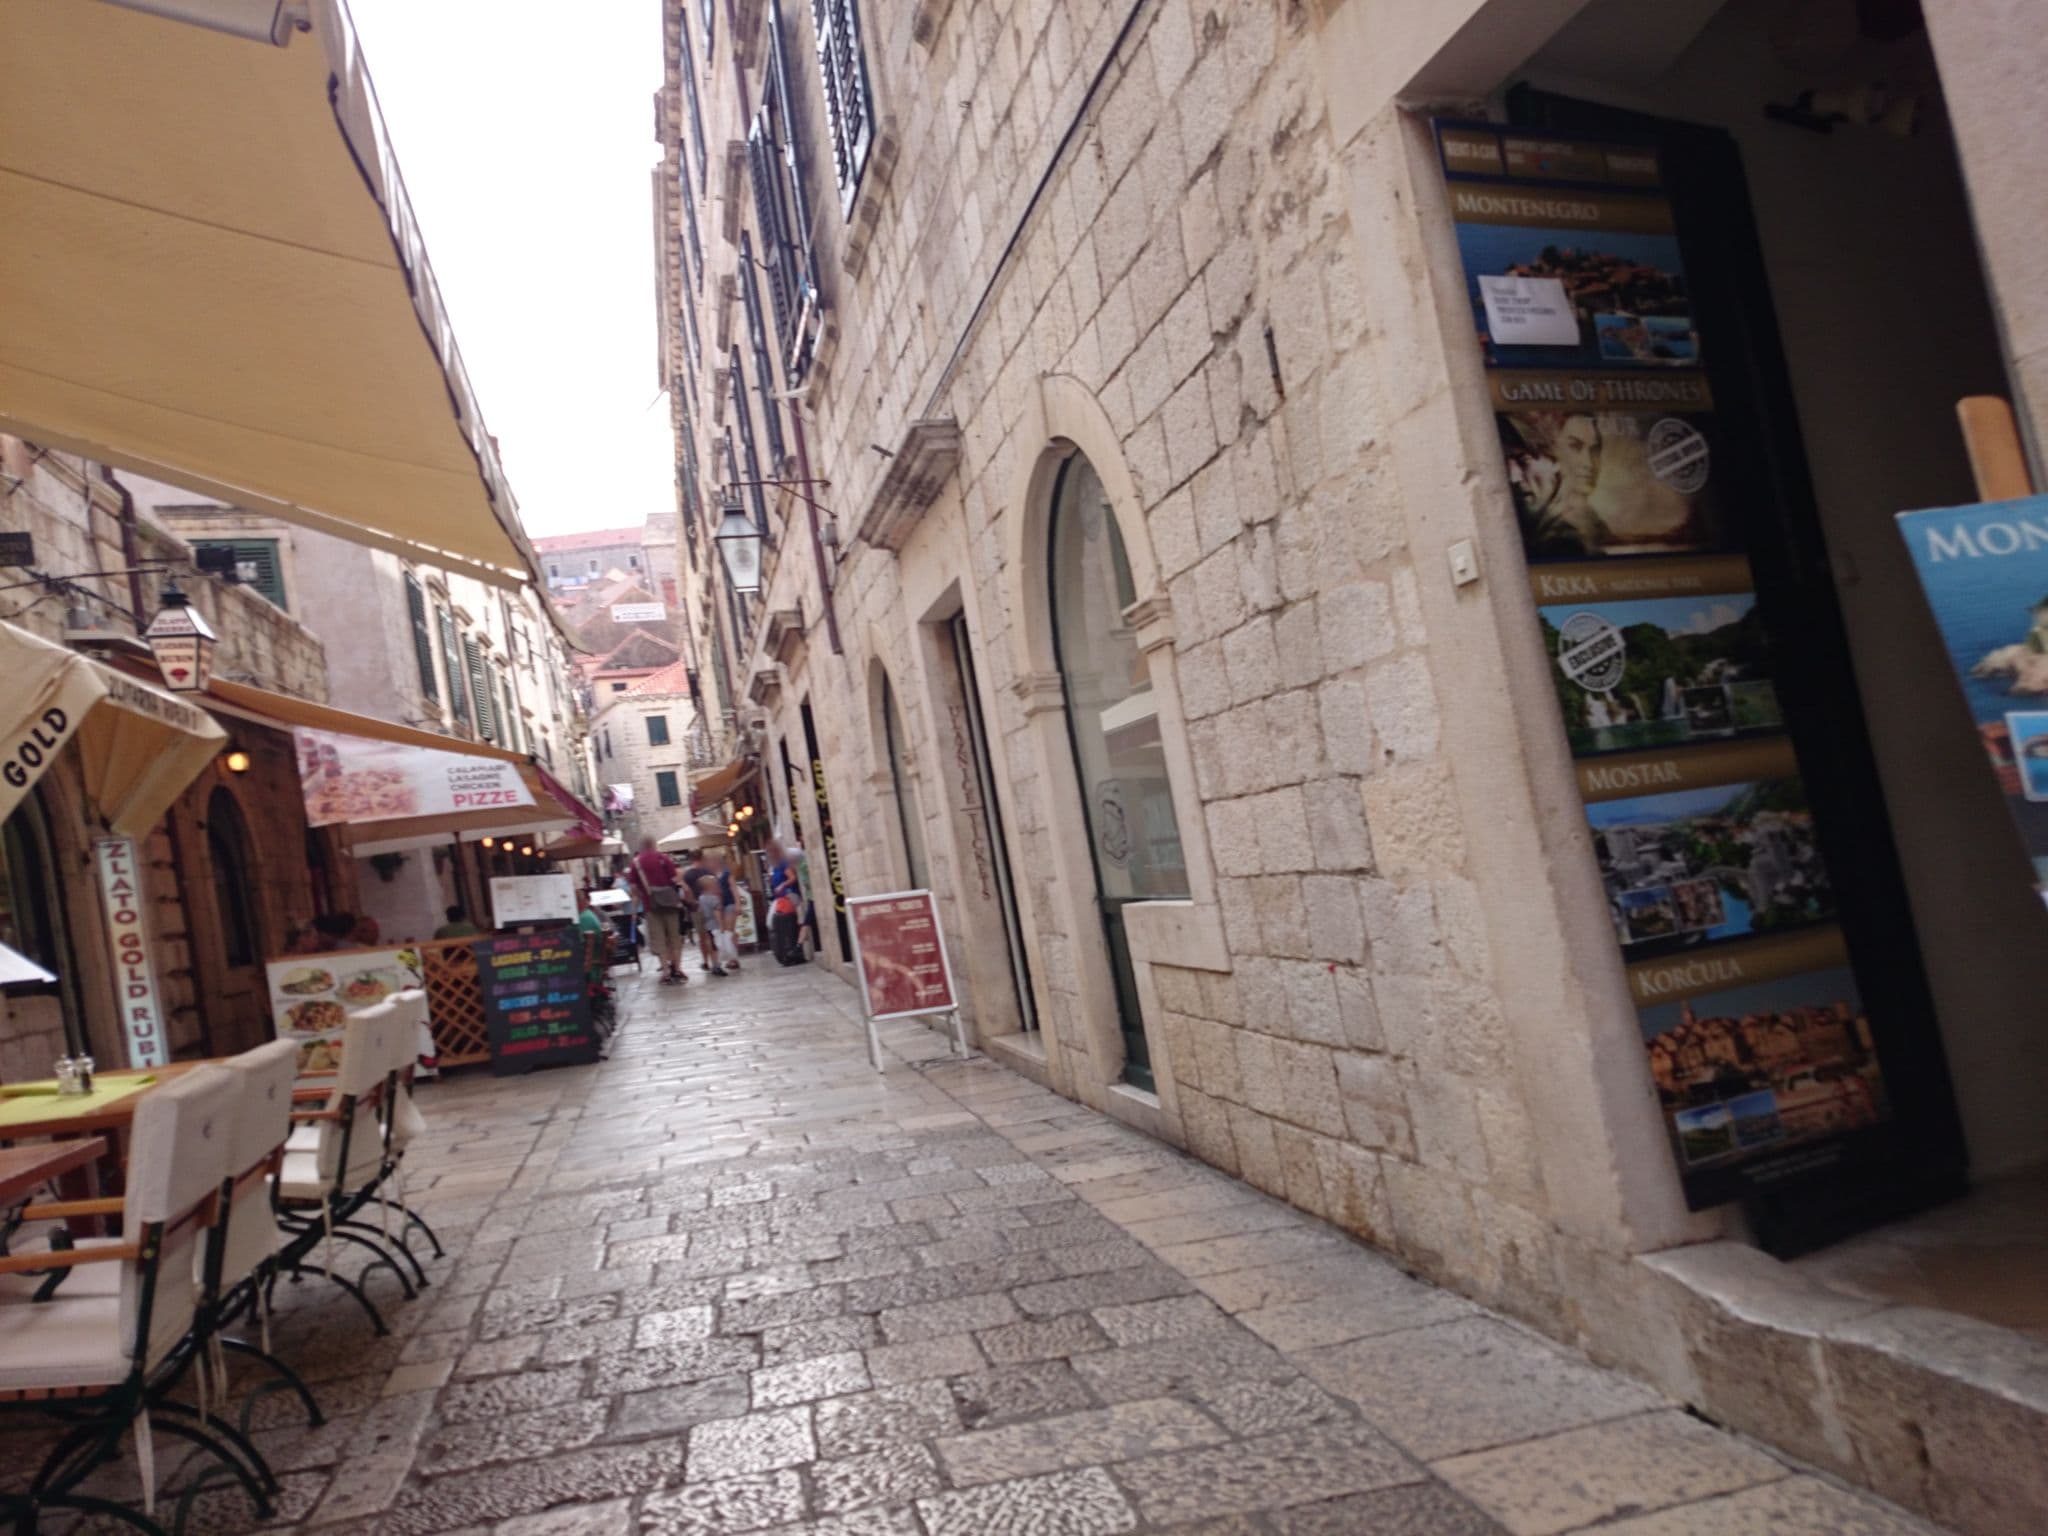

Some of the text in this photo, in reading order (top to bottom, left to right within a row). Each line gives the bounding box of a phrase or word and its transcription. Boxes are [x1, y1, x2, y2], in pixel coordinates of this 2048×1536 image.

[1457, 193, 1600, 221] MONTENEGRO
[1500, 379, 1700, 401] GAME OF THRONES
[1926, 516, 2048, 563] MON
[1539, 574, 1598, 597] KRKA
[3, 707, 67, 788] GOLD
[448, 773, 501, 783] LASAGNE
[1585, 760, 1682, 792] MOSTAR
[452, 790, 518, 807] PIZZE
[106, 842, 137, 924] ZLATO
[119, 933, 148, 999] GOLD
[1637, 957, 1745, 997] KORČULA
